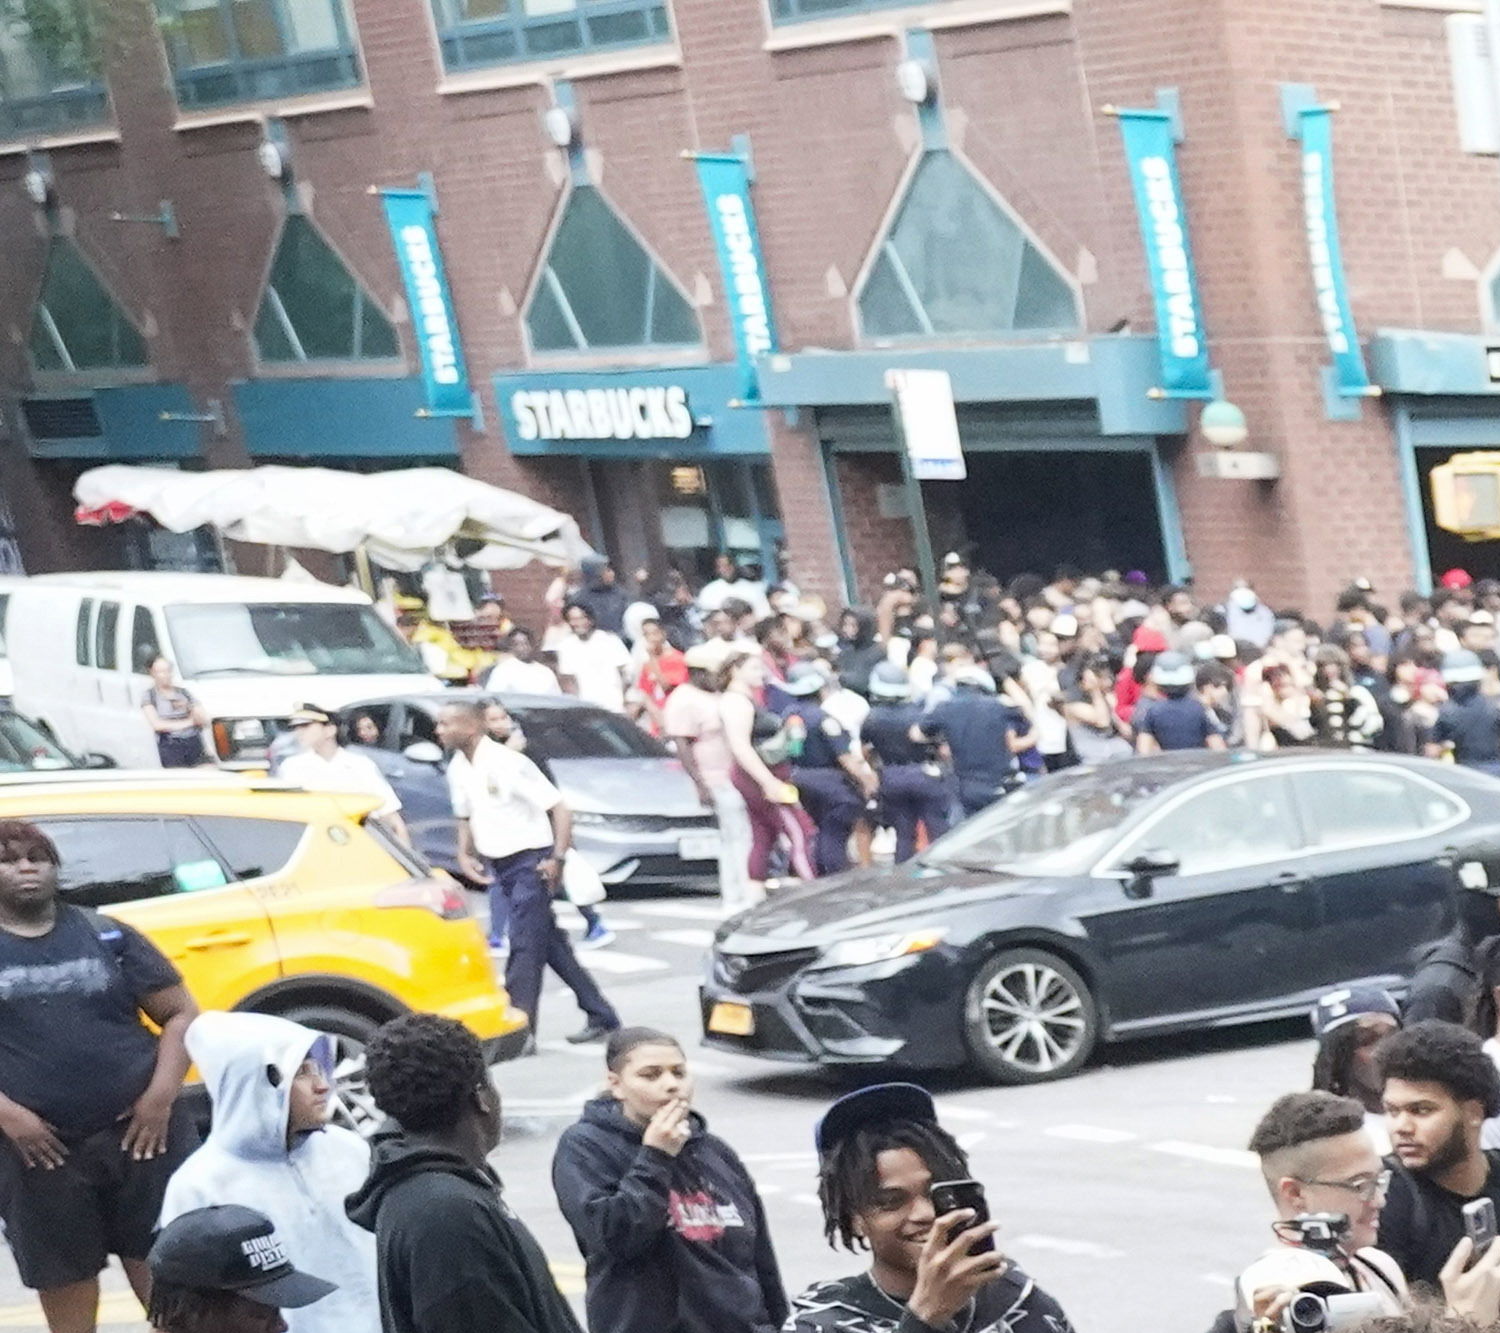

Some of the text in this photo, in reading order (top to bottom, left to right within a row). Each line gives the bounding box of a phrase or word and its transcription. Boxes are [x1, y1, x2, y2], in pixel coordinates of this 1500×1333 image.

[400, 225, 460, 385] STARBUCKS
[715, 193, 775, 362] TARBUCKS
[511, 386, 693, 440] STARBUCKS
